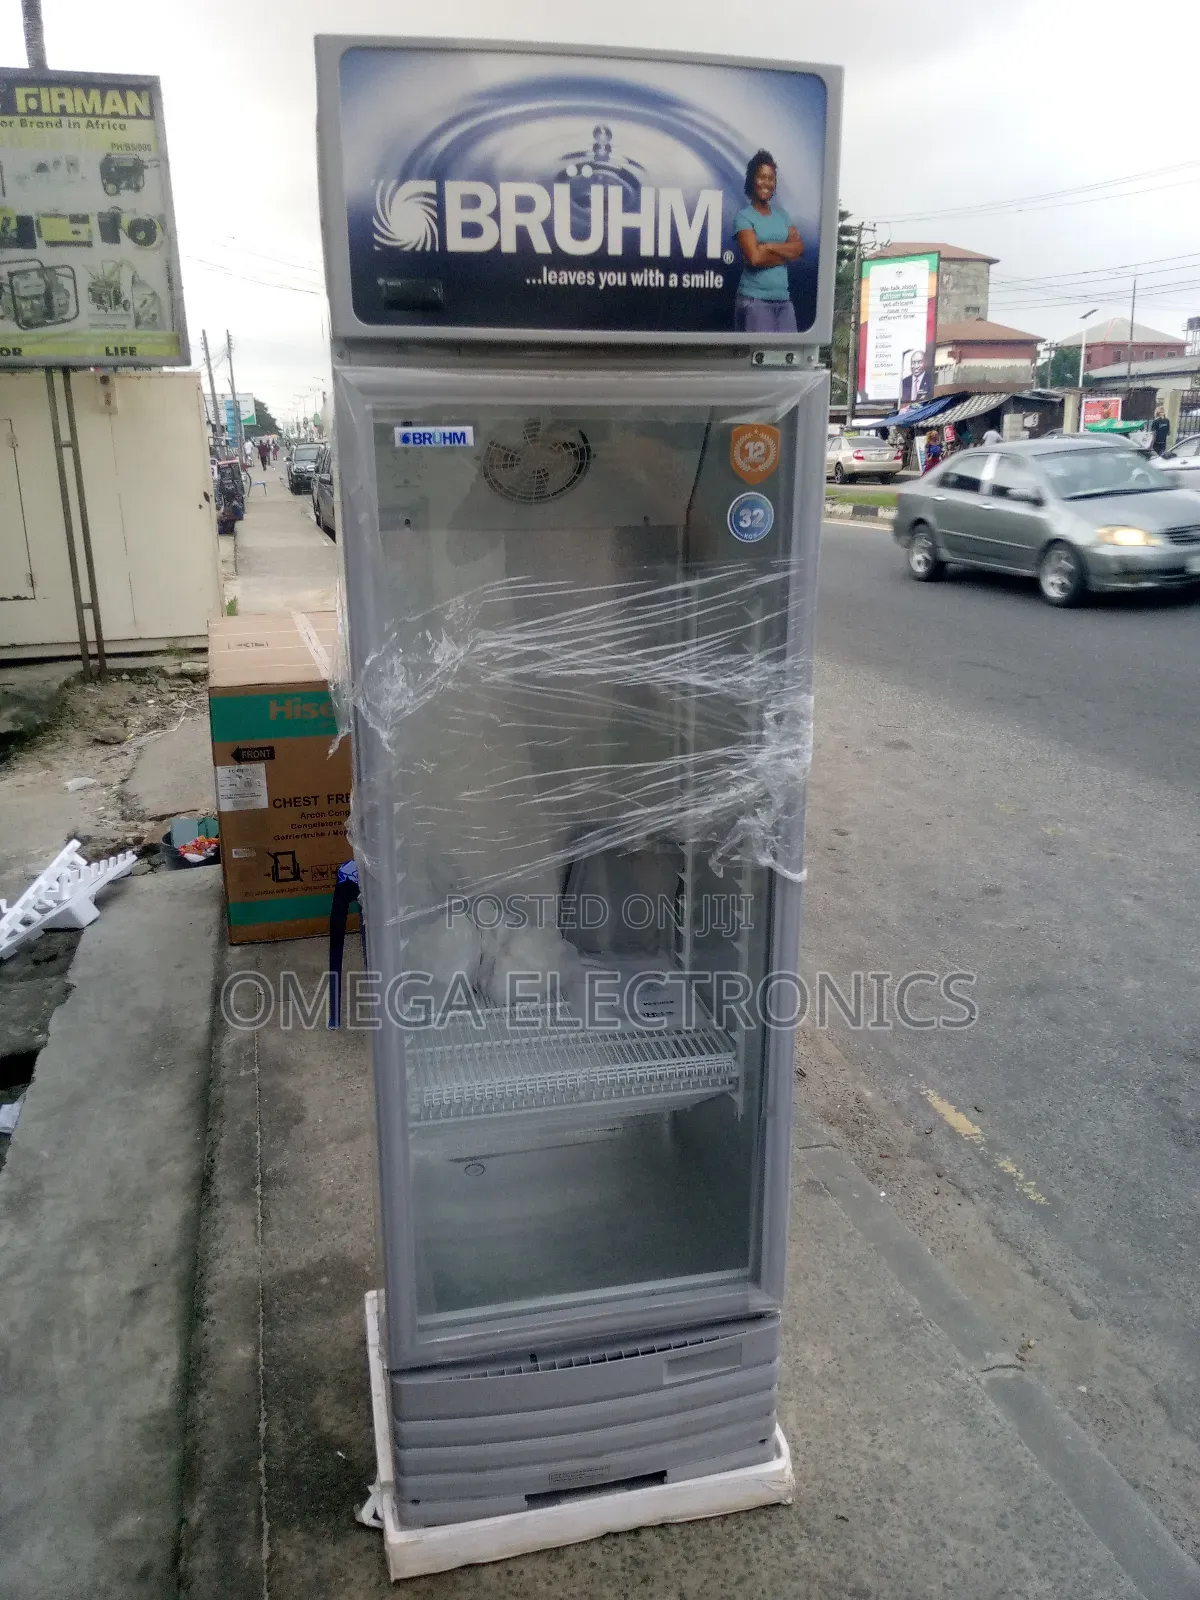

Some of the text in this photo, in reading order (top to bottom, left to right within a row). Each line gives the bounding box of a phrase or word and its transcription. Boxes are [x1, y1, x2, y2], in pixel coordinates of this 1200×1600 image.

[15, 87, 150, 116] FIRMAN
[20, 118, 63, 129] Brand
[68, 119, 81, 129] in
[86, 120, 127, 131] Africa
[599, 271, 627, 290] you
[631, 268, 664, 288] with
[668, 273, 678, 288] a
[682, 270, 724, 289] smile
[105, 346, 138, 357] LIFE
[744, 441, 766, 459] 12
[739, 508, 765, 528] 32
[241, 750, 271, 760] FRONT
[272, 795, 320, 809] CHEST
